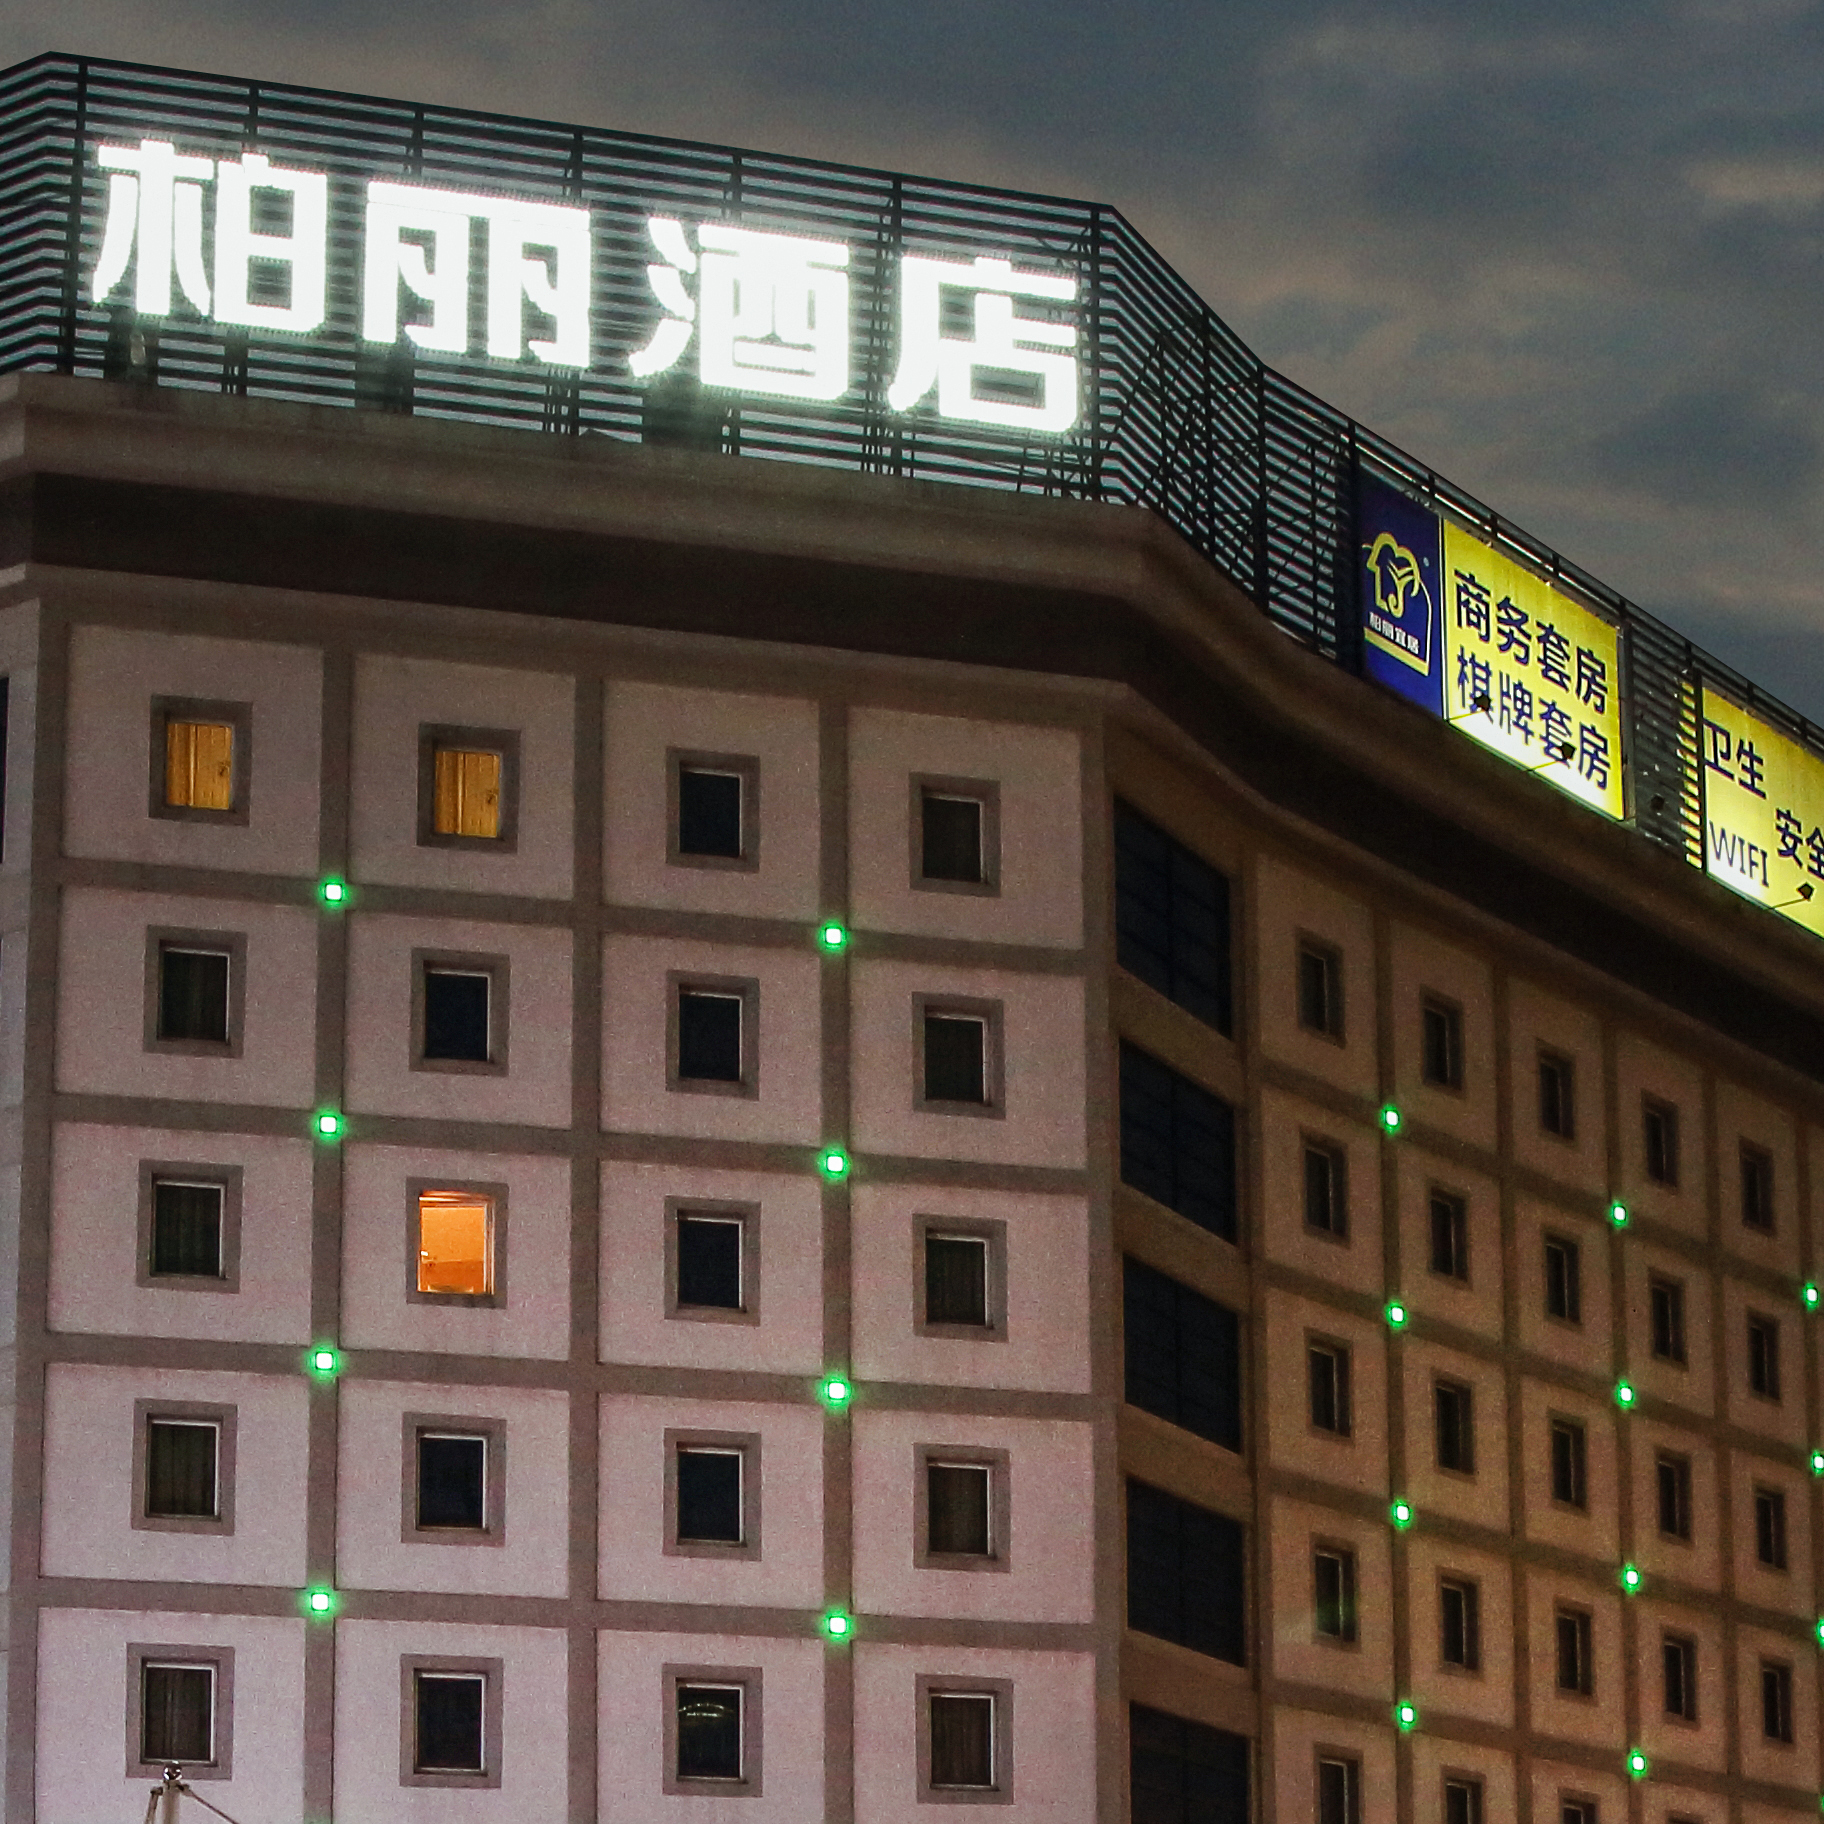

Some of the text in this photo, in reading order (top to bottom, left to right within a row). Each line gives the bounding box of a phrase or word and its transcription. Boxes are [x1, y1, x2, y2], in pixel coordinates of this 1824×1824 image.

[90, 136, 1080, 434] 柏丽酒店
[1454, 569, 1608, 716] 商务套房
[1457, 644, 1612, 792] 棋牌套房
[1703, 717, 1766, 800] 卫生
[1709, 821, 1770, 889] WIFI
